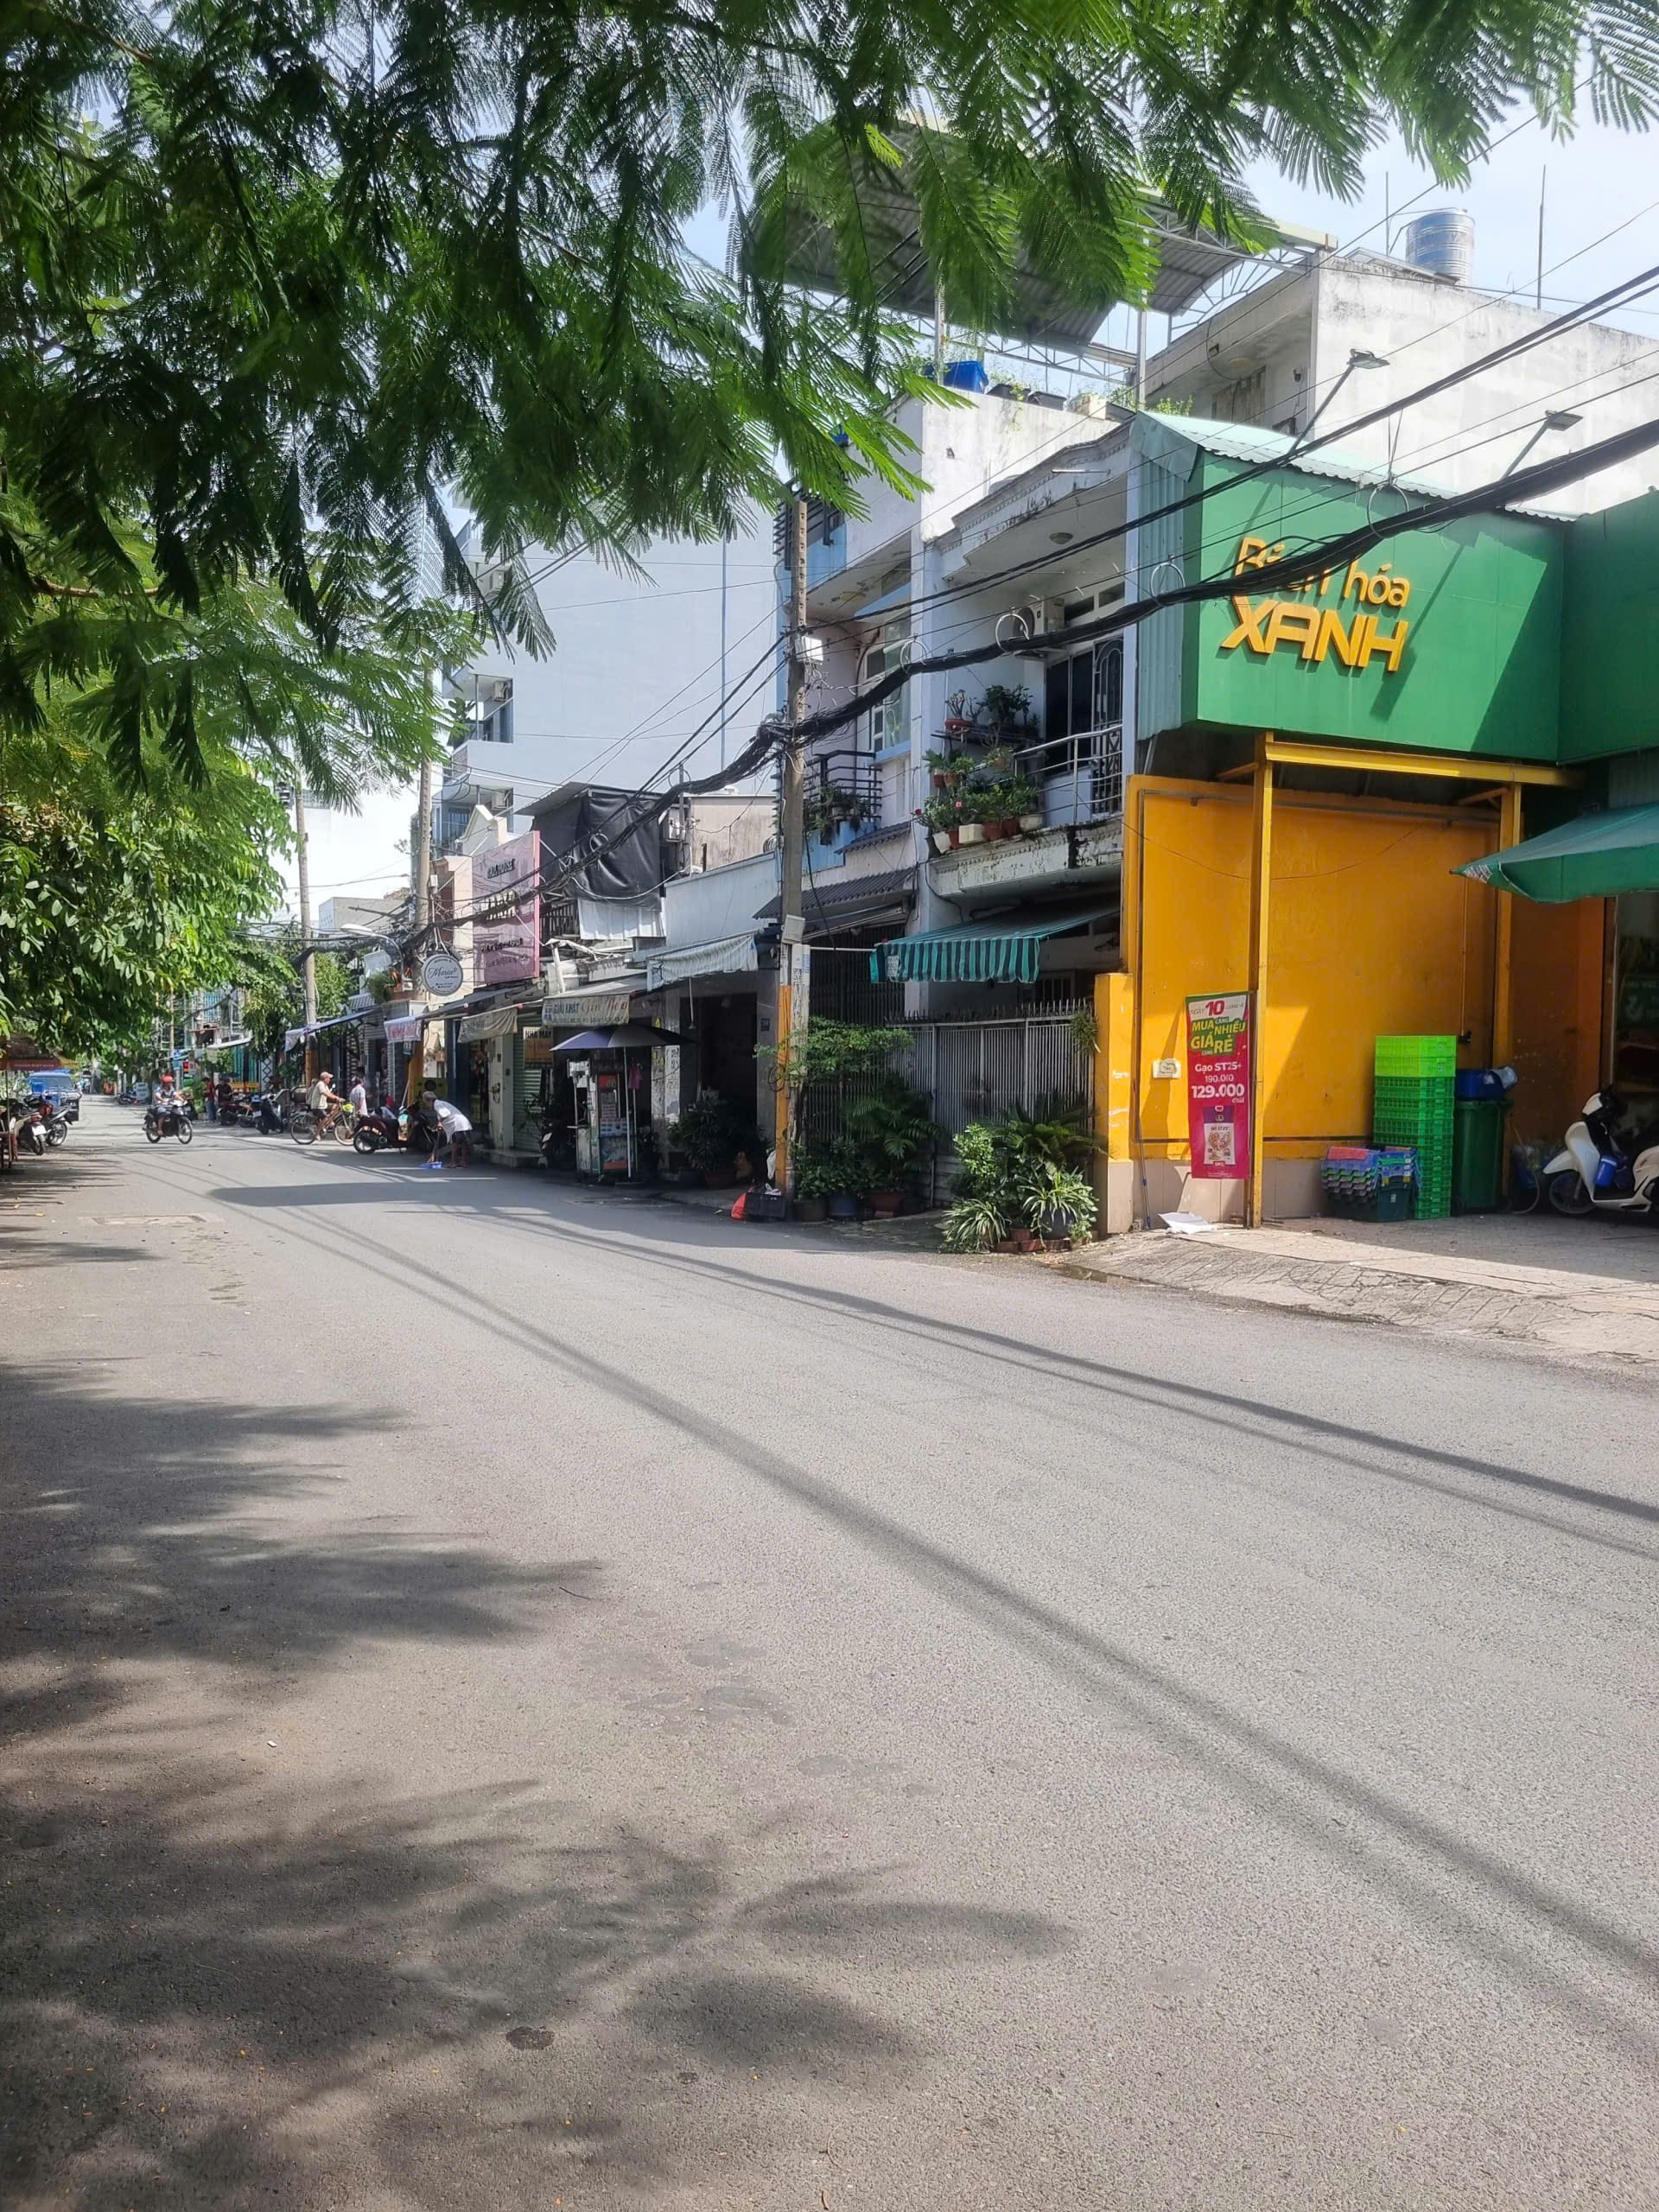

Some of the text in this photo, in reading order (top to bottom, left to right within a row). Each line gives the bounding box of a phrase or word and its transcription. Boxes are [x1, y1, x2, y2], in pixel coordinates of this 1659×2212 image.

[1344, 556, 1411, 608] hóa
[1220, 595, 1409, 673] XANH
[1205, 999, 1225, 1017] 10
[1192, 1019, 1214, 1032] MUA
[1190, 1031, 1214, 1050] GIÁ
[1213, 1034, 1233, 1054] RẺ
[1195, 1064, 1212, 1075] Gạo
[1191, 1083, 1245, 1099] 129.000
